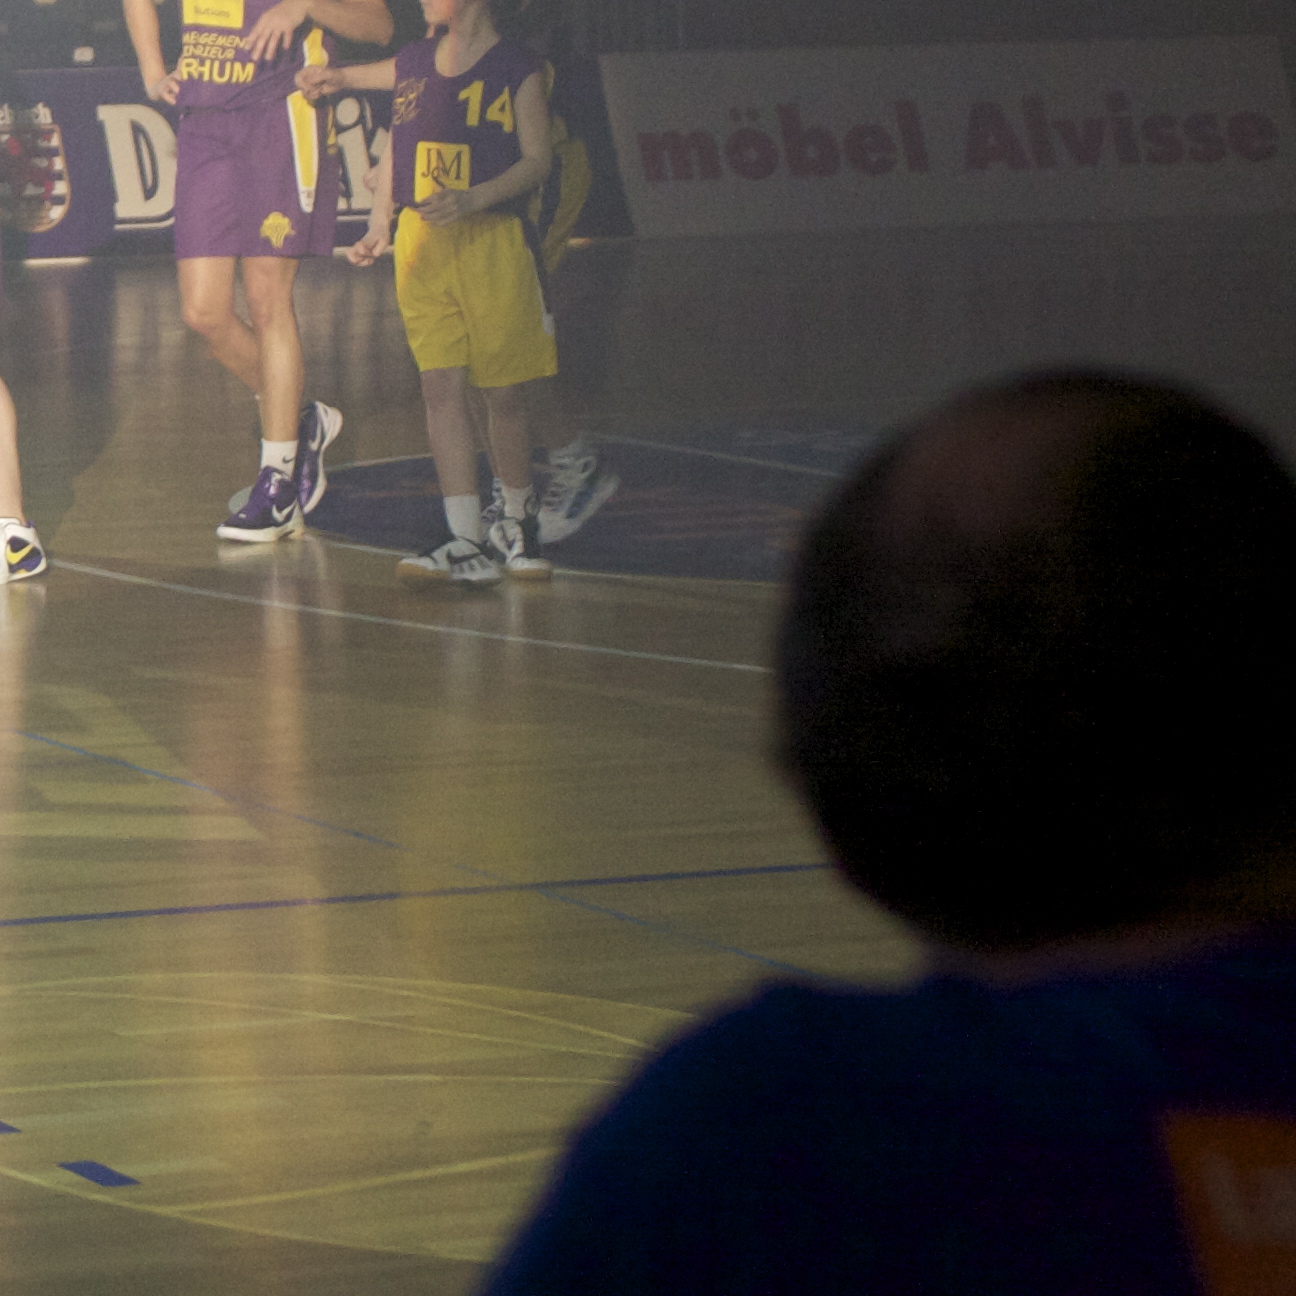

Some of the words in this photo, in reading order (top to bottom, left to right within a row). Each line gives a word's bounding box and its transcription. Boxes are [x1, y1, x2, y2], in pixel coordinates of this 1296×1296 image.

[458, 79, 514, 134] 14
[637, 103, 929, 183] möbel
[965, 91, 1279, 172] Alvisse
